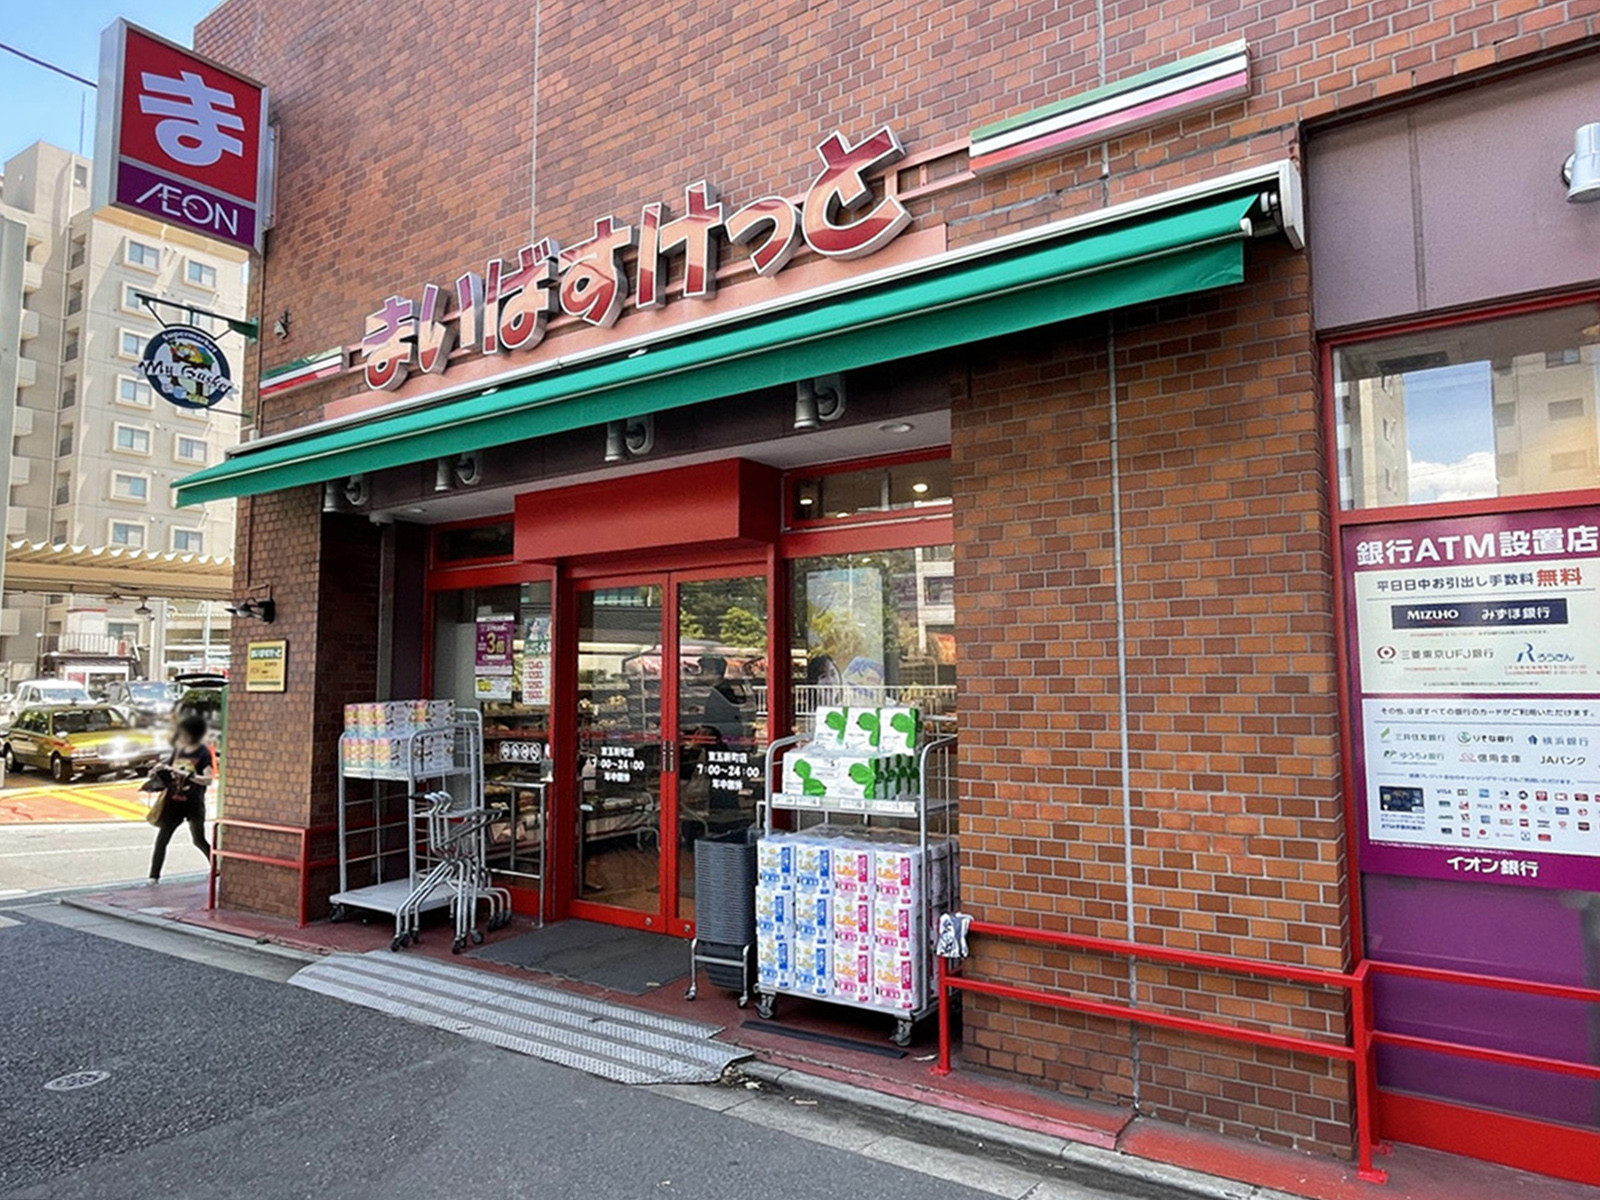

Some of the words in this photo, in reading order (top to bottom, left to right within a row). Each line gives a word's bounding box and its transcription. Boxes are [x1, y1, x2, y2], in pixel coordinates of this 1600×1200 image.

[138, 70, 244, 166] ま
[362, 126, 912, 390] まいばすけっと
[1356, 525, 1599, 566] 銀行ATM設置店
[1407, 608, 1459, 620] MIZUHO
[1481, 606, 1551, 620] みずほ銀行
[1401, 648, 1494, 660] 三菱東京UFJ銀行
[1540, 755, 1587, 766] JAバンク
[1447, 856, 1539, 878] イオン銀行
